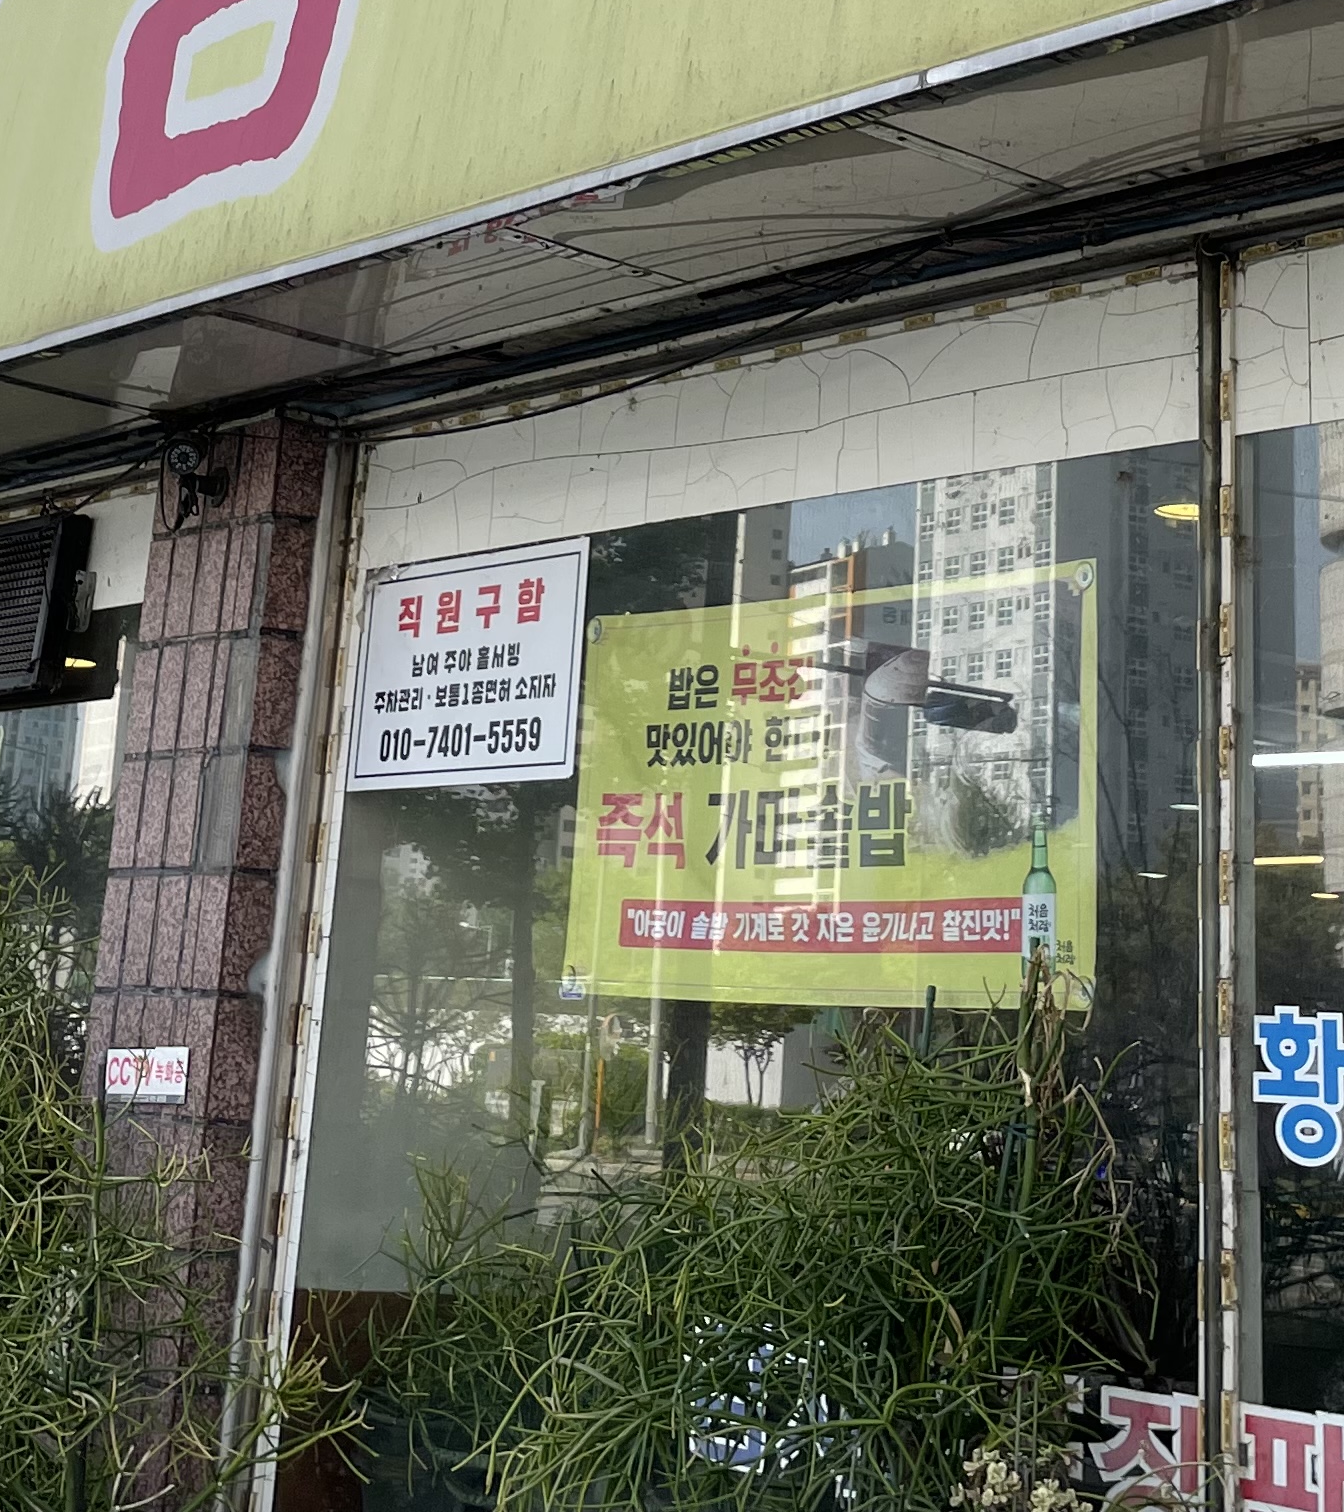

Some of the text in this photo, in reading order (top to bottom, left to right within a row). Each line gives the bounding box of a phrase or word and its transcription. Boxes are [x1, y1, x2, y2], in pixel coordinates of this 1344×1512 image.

[411, 642, 522, 678] 남여 주야 홀서빙
[373, 687, 424, 715] 주차관리
[514, 673, 558, 700] 소지자
[667, 663, 720, 711] 밥은
[379, 716, 543, 763] 010-7401-5559
[646, 719, 754, 769] 맛있어야
[595, 791, 687, 870] 즉석
[732, 912, 786, 942] 기계로
[790, 913, 811, 942] 갓
[815, 912, 856, 943] 지은
[862, 911, 936, 942] 윤기나고
[108, 1056, 155, 1086] CCTV
